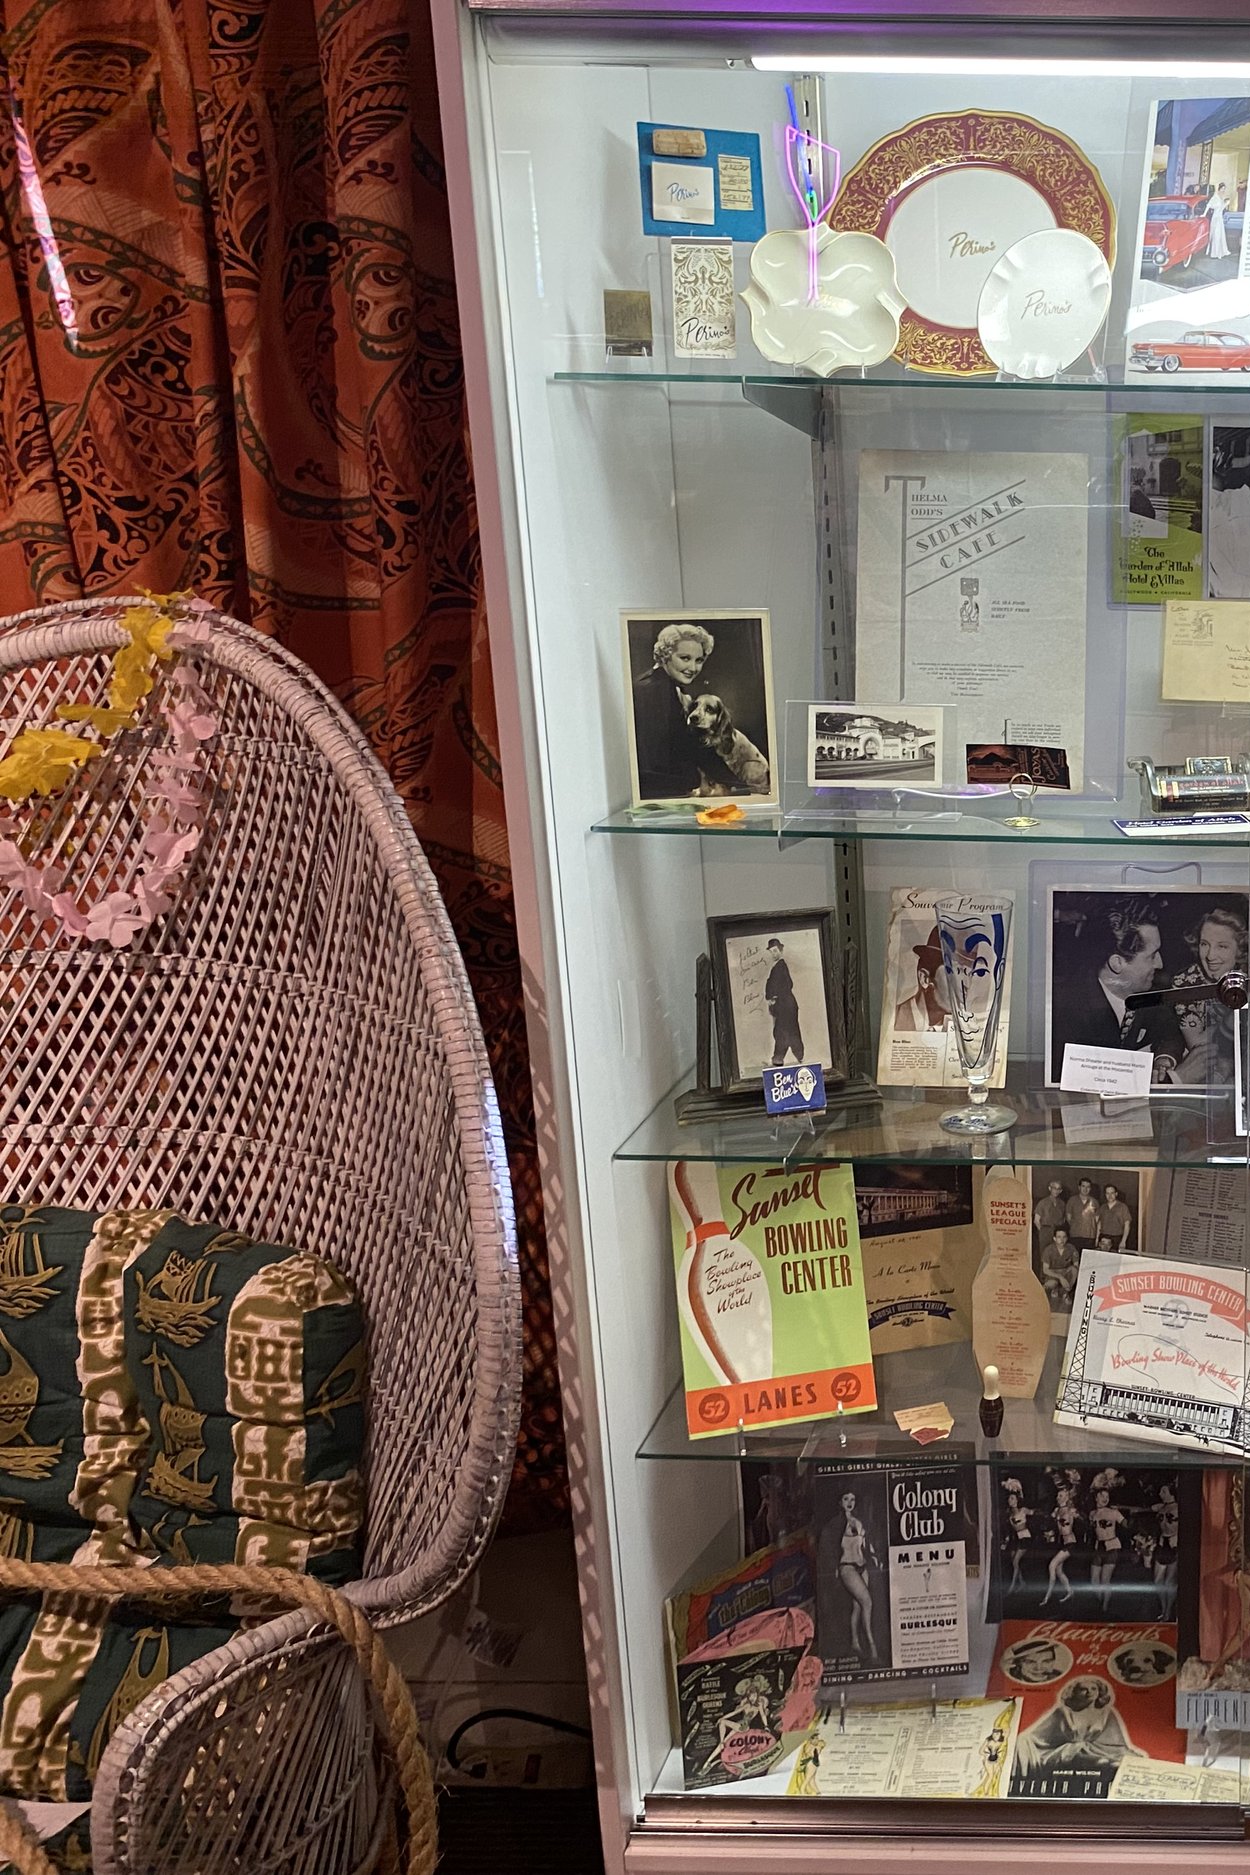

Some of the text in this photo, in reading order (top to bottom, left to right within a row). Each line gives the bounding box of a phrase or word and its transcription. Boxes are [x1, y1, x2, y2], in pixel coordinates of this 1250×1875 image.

[948, 231, 996, 259] Perino's
[1021, 289, 1073, 320] Perino's
[680, 317, 730, 343] Perino's
[915, 491, 1024, 553] SIDEWALK
[939, 530, 1002, 569] CAFE
[1144, 547, 1165, 558] The
[958, 898, 1004, 913] Program
[774, 1072, 793, 1088] Ben
[771, 1083, 799, 1103] Blue's
[730, 1163, 840, 1240] Sunset
[990, 1201, 1027, 1210] SUNSET'S
[990, 1209, 1026, 1218] LEAGUE
[990, 1218, 1027, 1226] SPECIALS
[764, 1217, 848, 1259] BOWLING
[713, 1248, 735, 1263] The
[705, 1259, 753, 1281] Bowling
[781, 1254, 852, 1295] CENTER
[706, 1271, 762, 1295] Showplace
[1117, 1276, 1243, 1312] SUNSET BOWLING CENTER
[717, 1292, 752, 1314] World
[1080, 1275, 1096, 1335] BOWLING
[1111, 1351, 1150, 1370] Bowling
[1151, 1347, 1176, 1362] Show
[1175, 1351, 1197, 1368] Place
[1198, 1361, 1208, 1376] of
[1218, 1370, 1241, 1391] World
[703, 1379, 858, 1418] 52 LANES 52
[1131, 1384, 1149, 1393] SUNSET
[1151, 1388, 1175, 1398] BOWLING
[817, 1462, 874, 1473] GIRLS! GIRLS!
[892, 1481, 958, 1514] Colony
[899, 1509, 945, 1541] Club
[897, 1548, 956, 1564] MENU
[900, 1618, 958, 1630] BURLESQUE
[1026, 1621, 1160, 1642] Blackouts
[823, 1665, 968, 1684] DINING DANCING COCKTAILS
[729, 1734, 773, 1748] COLONY
